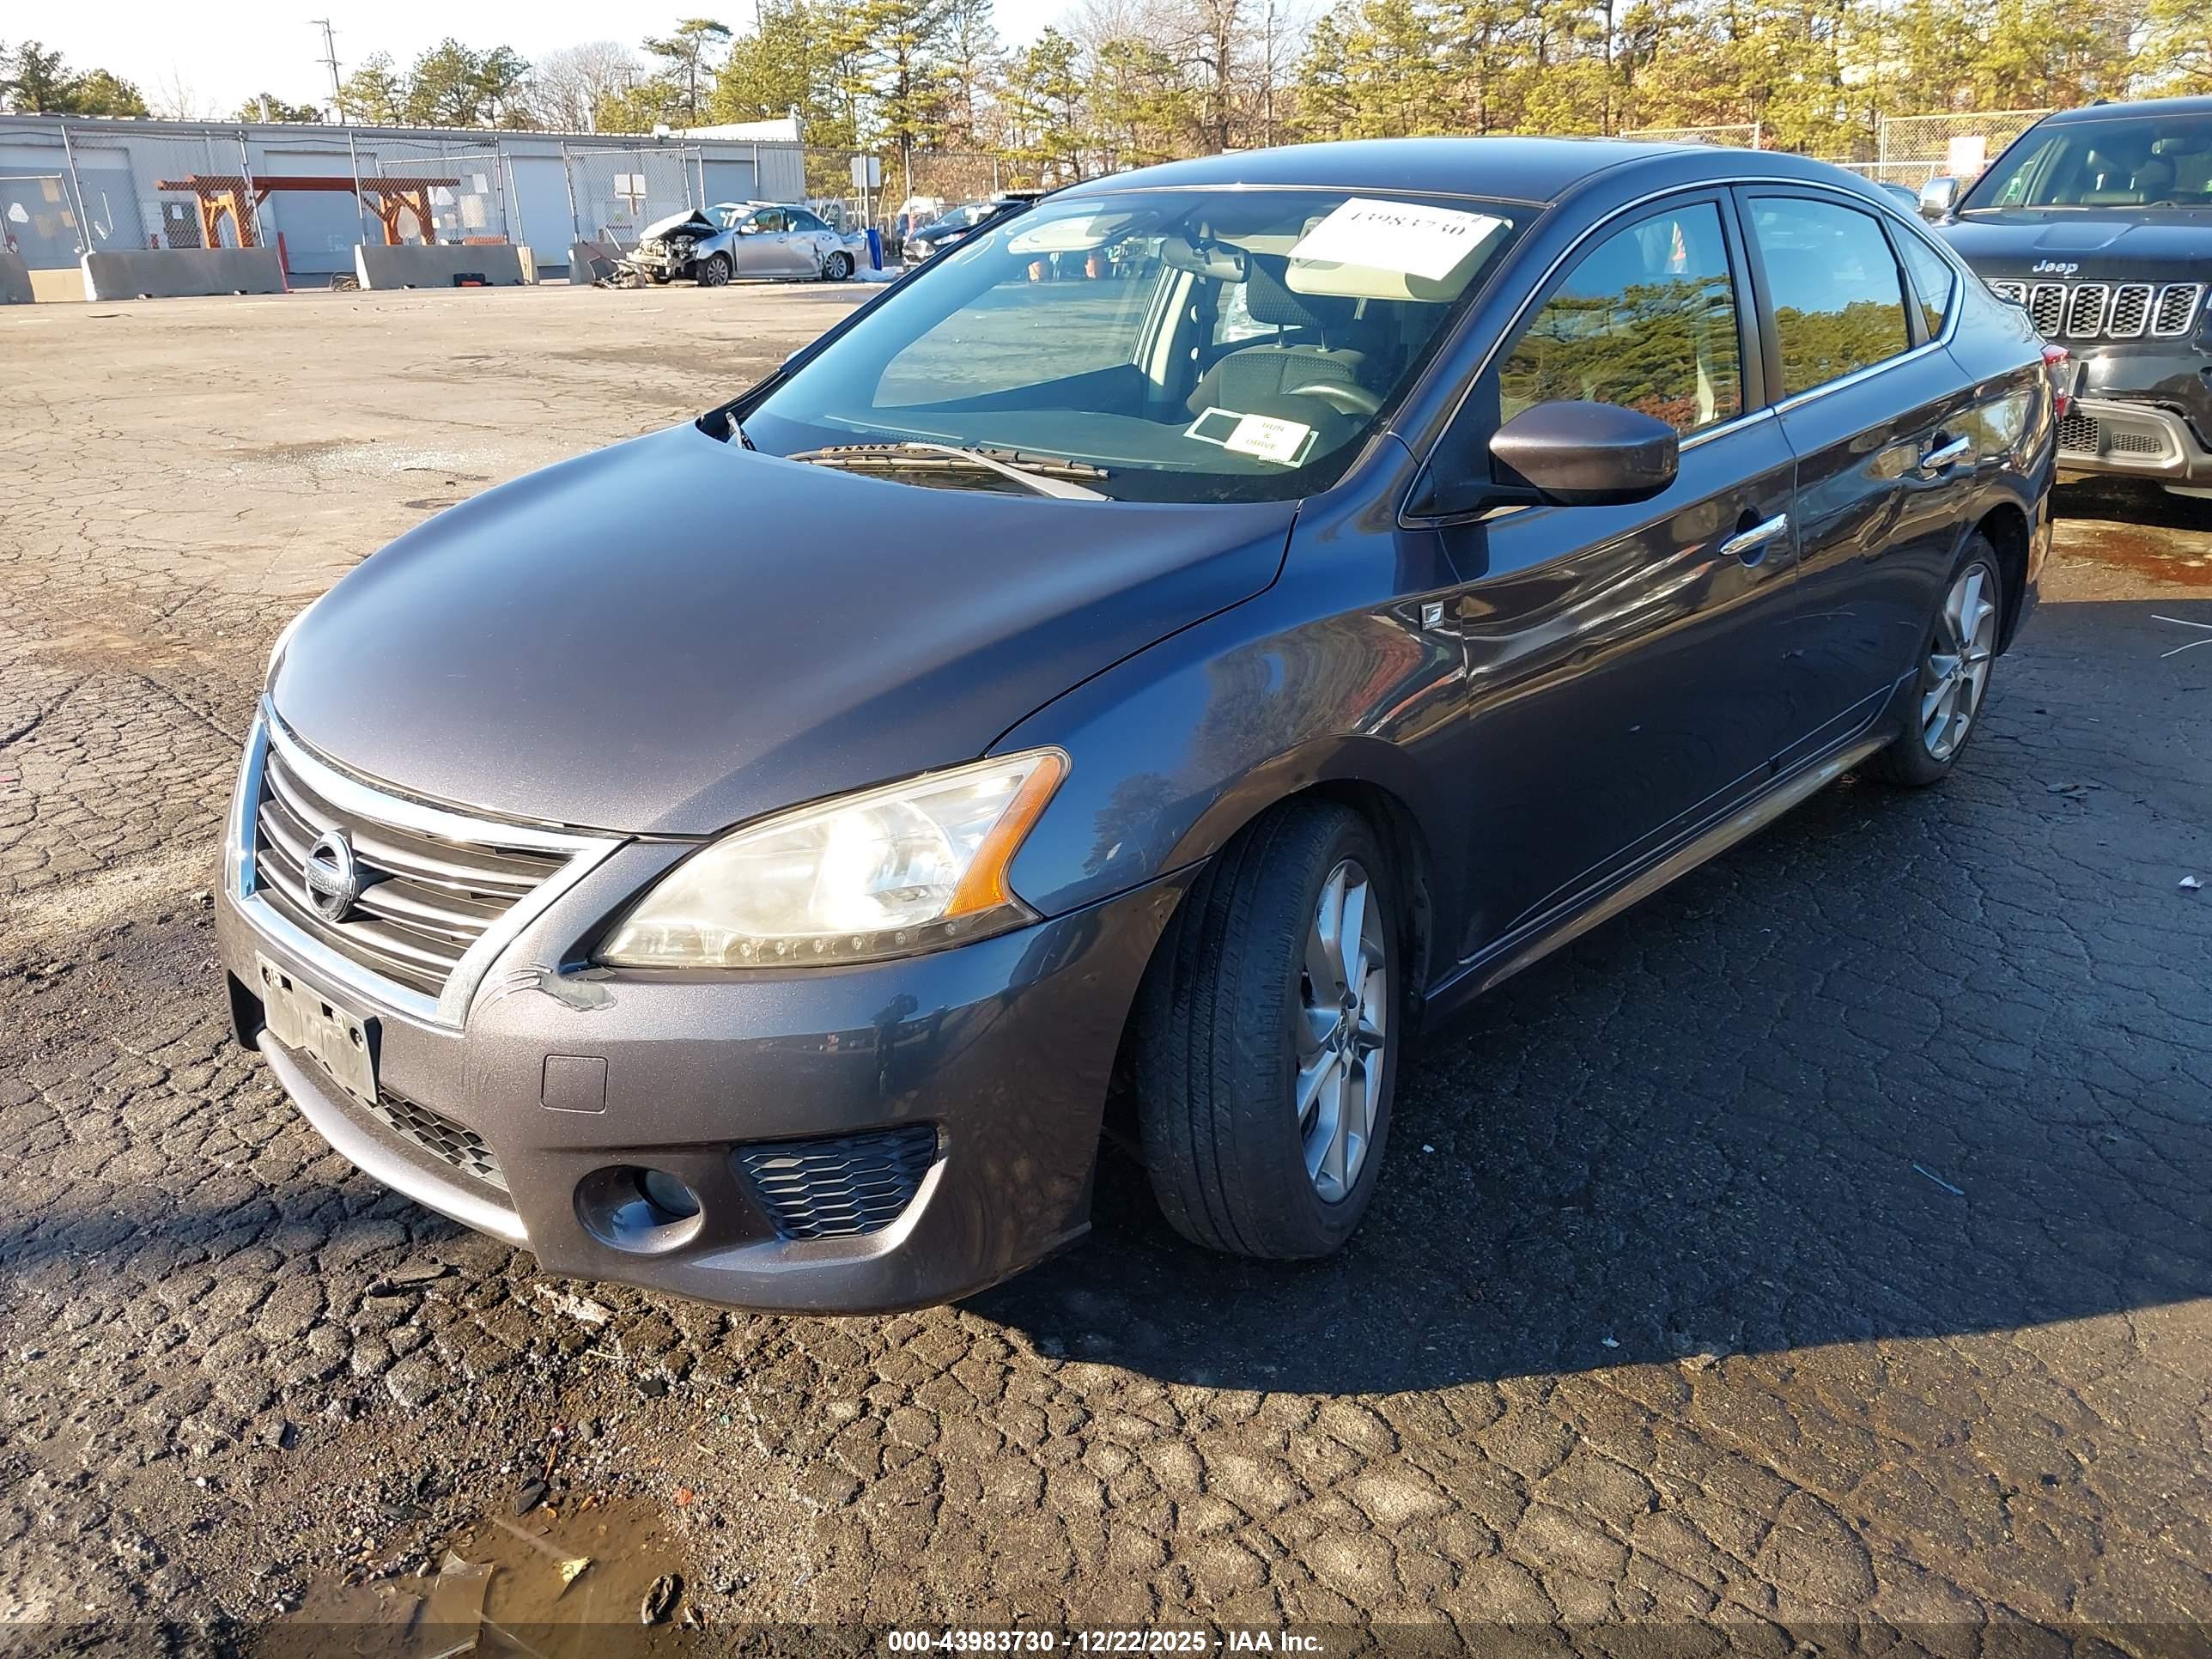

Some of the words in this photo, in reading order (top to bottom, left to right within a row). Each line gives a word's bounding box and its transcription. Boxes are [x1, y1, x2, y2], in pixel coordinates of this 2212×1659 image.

[2033, 259, 2079, 275] Jeep
[1262, 422, 1285, 432] RUN
[1245, 439, 1278, 450] DRIVE
